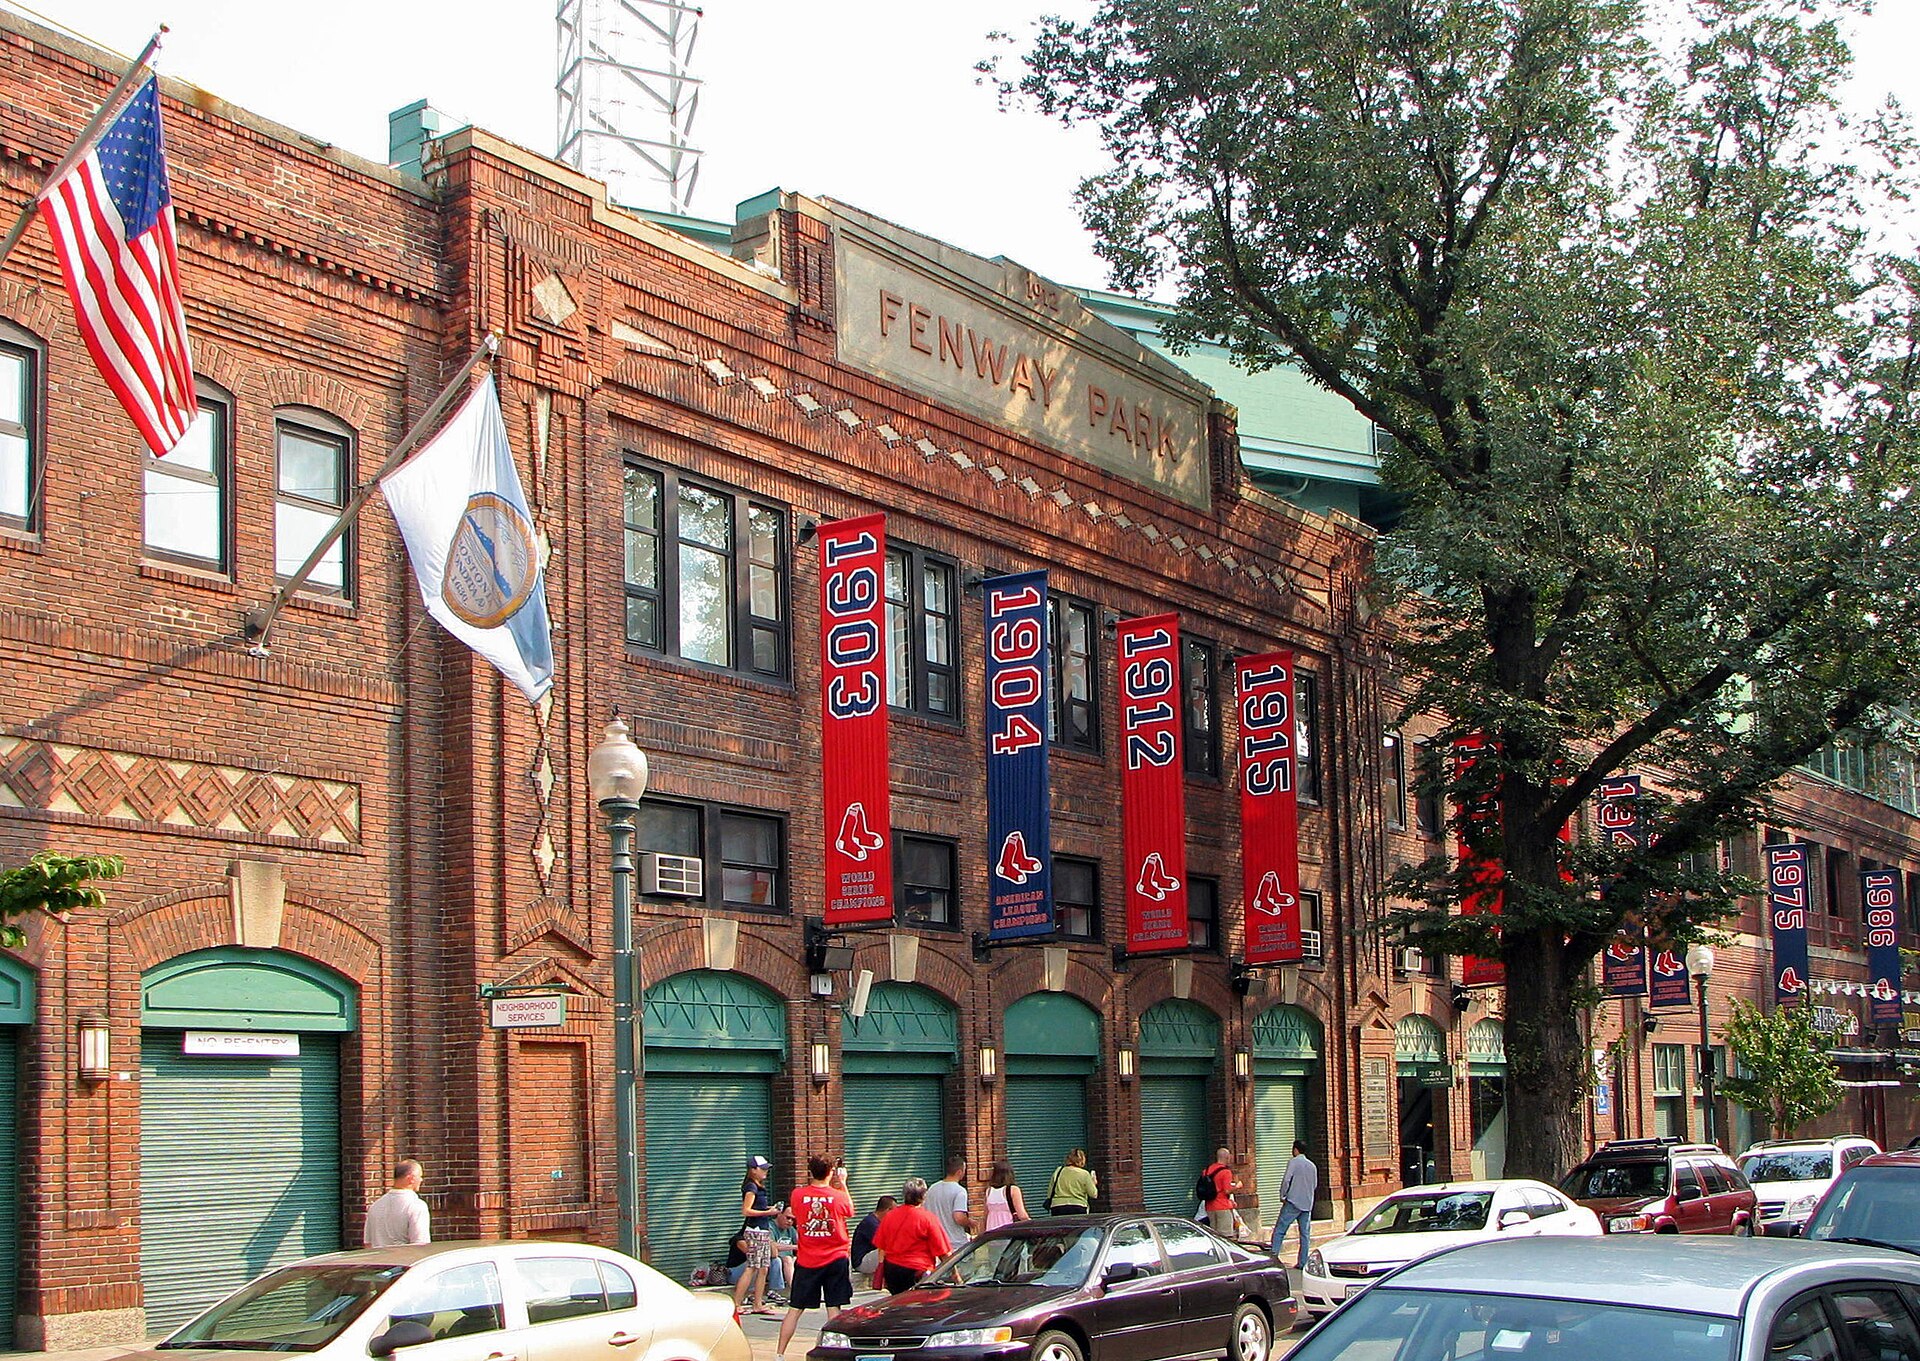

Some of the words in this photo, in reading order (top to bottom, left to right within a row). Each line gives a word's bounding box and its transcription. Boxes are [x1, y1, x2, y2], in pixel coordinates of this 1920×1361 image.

[879, 288, 1055, 409] FENWAY
[1088, 384, 1178, 462] PARK
[825, 531, 880, 719] 1903
[991, 586, 1042, 754] 1904
[1124, 628, 1175, 770] 1912
[1242, 664, 1291, 795] 1915
[841, 871, 875, 883] WORLD
[995, 890, 1044, 906] AMERICAN
[1772, 850, 1804, 930] 1975
[831, 896, 885, 910] CHAMPIONS
[1002, 903, 1037, 916] LEAGUE
[1866, 875, 1895, 947] 1986
[993, 913, 1048, 929] CHAMPIONS
[496, 1001, 558, 1012] NEIGHBORHOOD
[507, 1012, 546, 1022] SERVICES
[198, 1037, 217, 1048] NO
